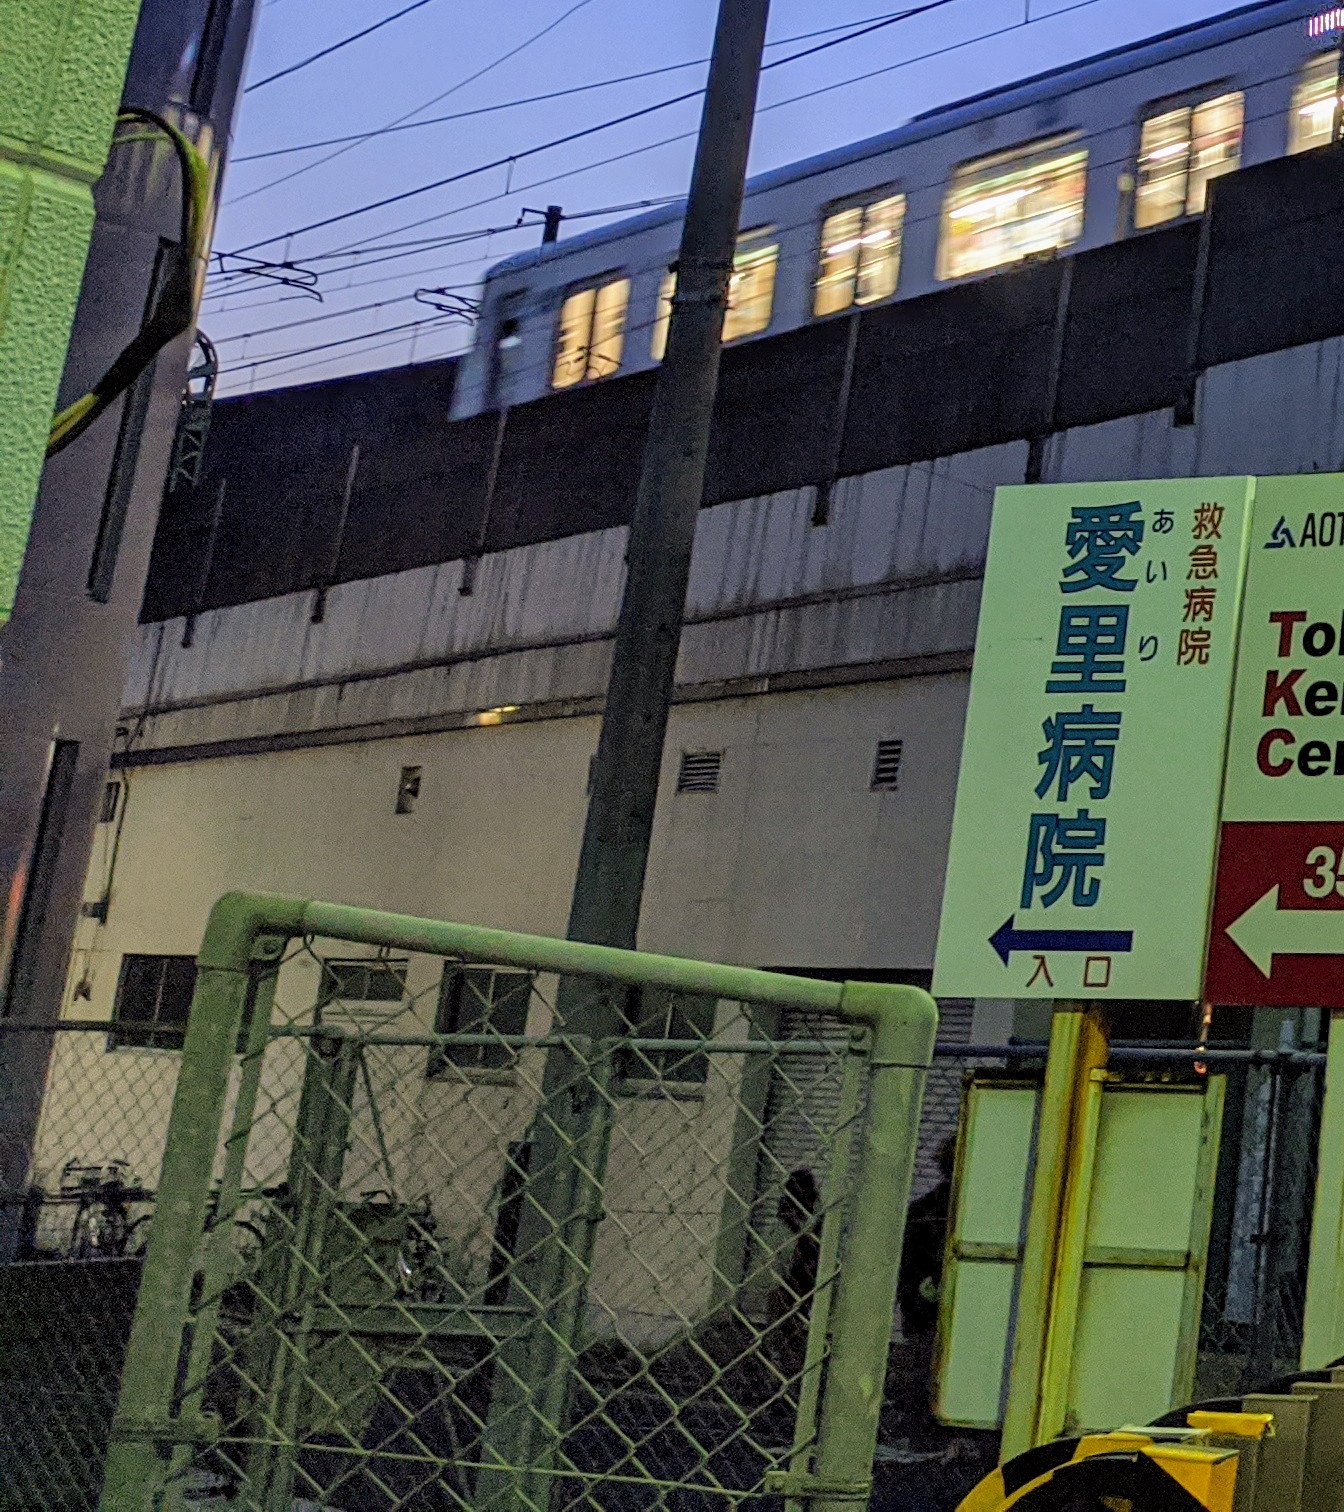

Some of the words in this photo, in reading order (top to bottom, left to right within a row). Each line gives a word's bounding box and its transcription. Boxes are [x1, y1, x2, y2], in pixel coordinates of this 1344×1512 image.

[1139, 508, 1175, 662] あいり
[1175, 501, 1225, 667] 救急病院
[1019, 500, 1145, 909] 愛里病院
[1026, 955, 1111, 988] 入口
